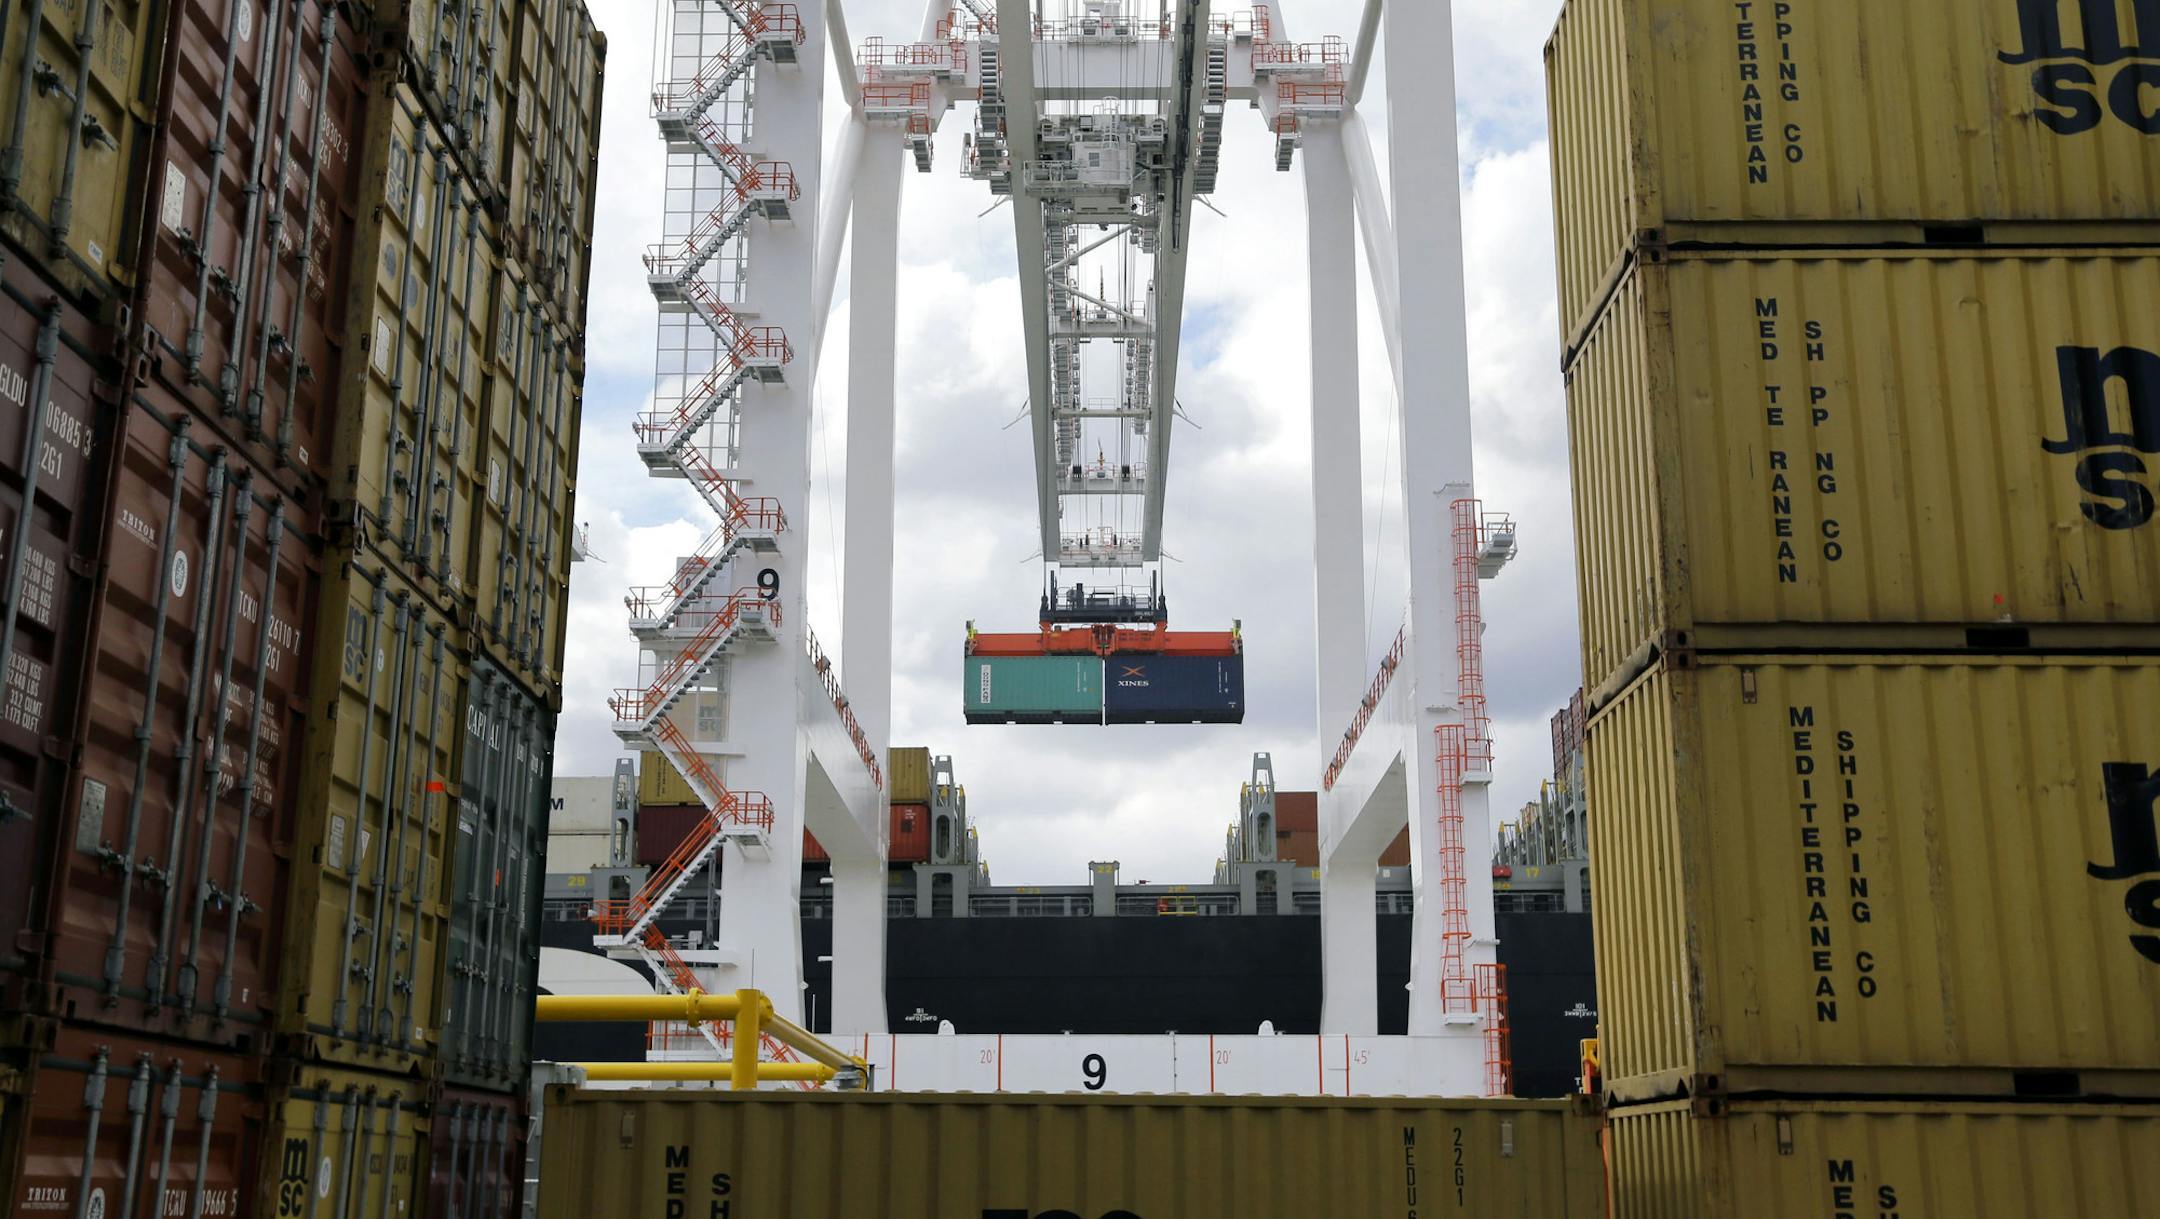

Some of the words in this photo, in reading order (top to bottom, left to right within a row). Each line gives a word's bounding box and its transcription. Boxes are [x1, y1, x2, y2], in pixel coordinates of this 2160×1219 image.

[1784, 124, 1803, 163] CO
[122, 509, 156, 541] TRITON
[1822, 520, 1842, 561] CO
[757, 568, 779, 601] 9
[467, 704, 499, 751] CAPIAL
[1790, 706, 1837, 1022] MEDITERRANEAN
[1837, 731, 1871, 923] SHIPPING
[1856, 951, 1877, 998] CO
[1082, 1053, 1107, 1090] 9
[1453, 1127, 1464, 1207] 22G1
[27, 1187, 67, 1202] TRITON
[1828, 1160, 1854, 1219] ME
[1878, 1185, 1898, 1219] S
